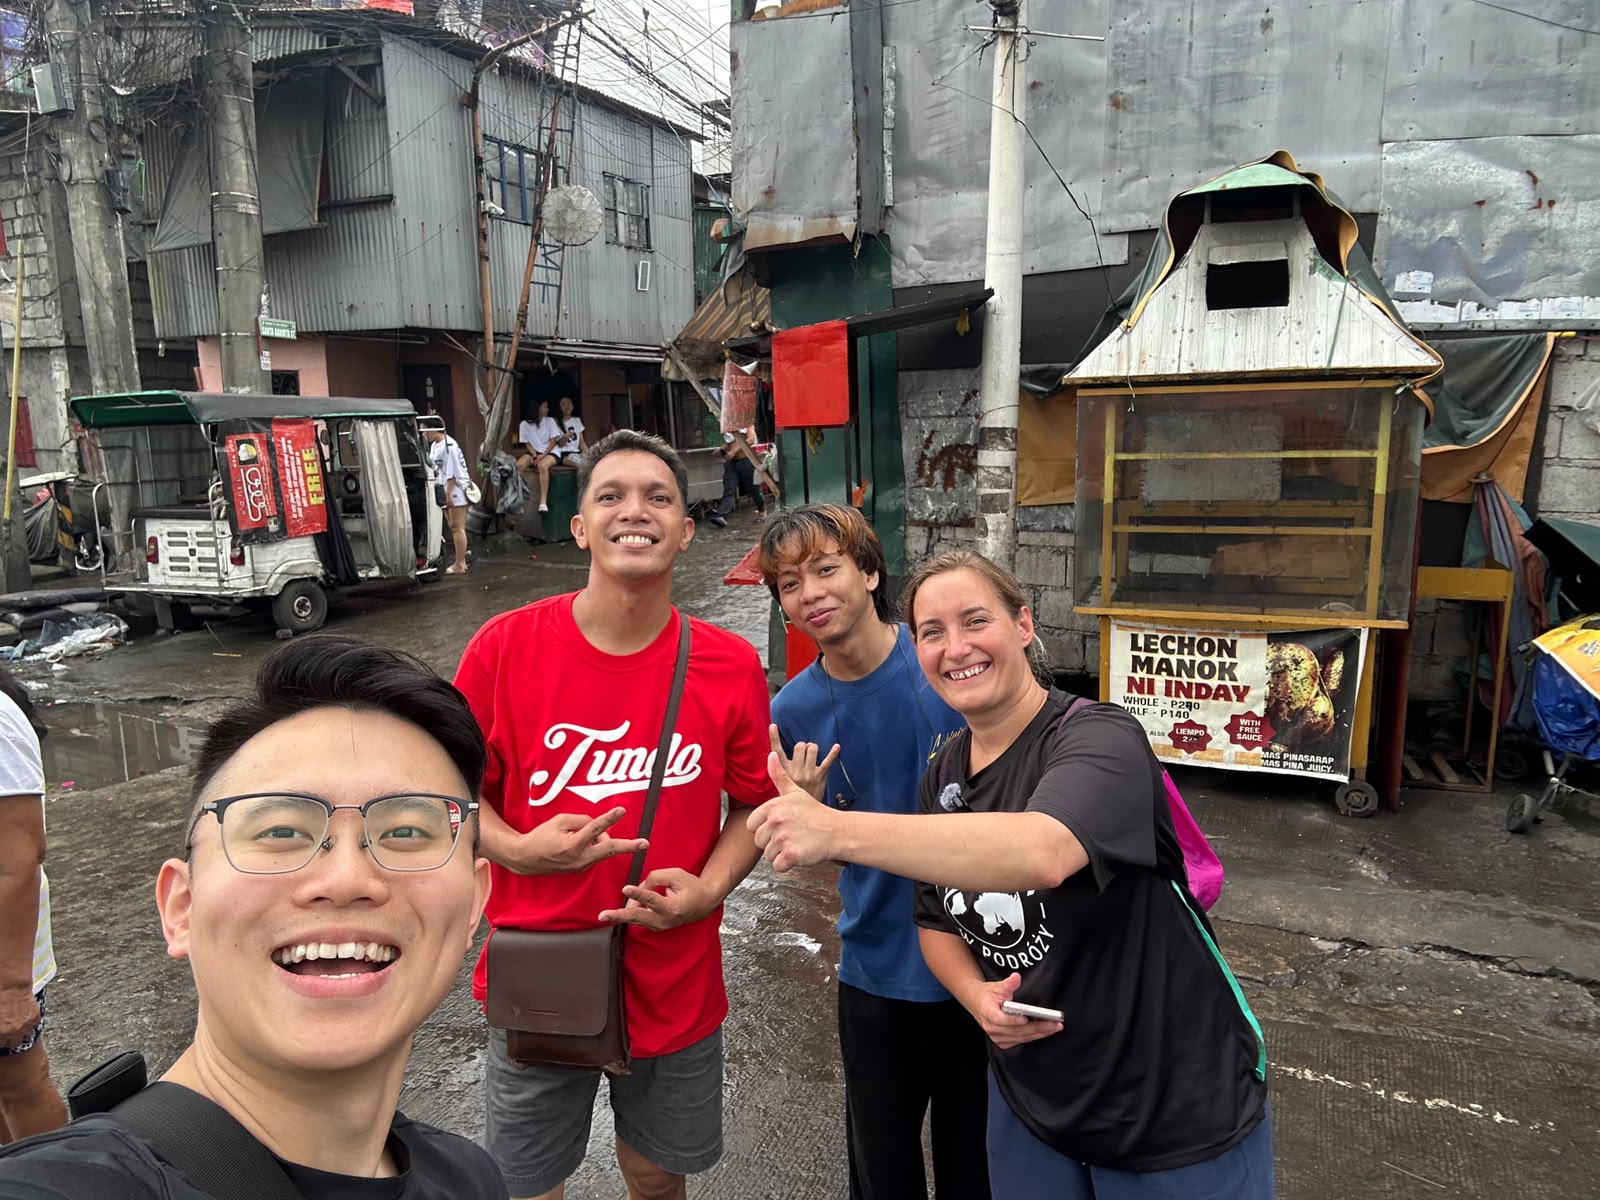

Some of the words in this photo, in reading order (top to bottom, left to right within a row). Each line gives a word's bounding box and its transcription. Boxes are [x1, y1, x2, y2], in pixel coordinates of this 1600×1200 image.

[301, 448, 325, 505] FREE
[1130, 633, 1237, 658] LECHON
[1131, 655, 1239, 681] MANOK
[1127, 676, 1155, 696] NI
[1164, 679, 1251, 703] INDAY
[1123, 695, 1159, 707] WHOLE
[1160, 709, 1190, 719] P140
[1240, 718, 1261, 726] WITH
[1176, 728, 1205, 736] LIEMPO
[1239, 726, 1260, 734] FREE
[1236, 733, 1263, 742] SAUCE
[1261, 751, 1281, 759] MAS
[1283, 753, 1335, 764] PINASARAP
[1282, 760, 1304, 770] PINA
[982, 923, 1055, 970] PODRÓŻY
